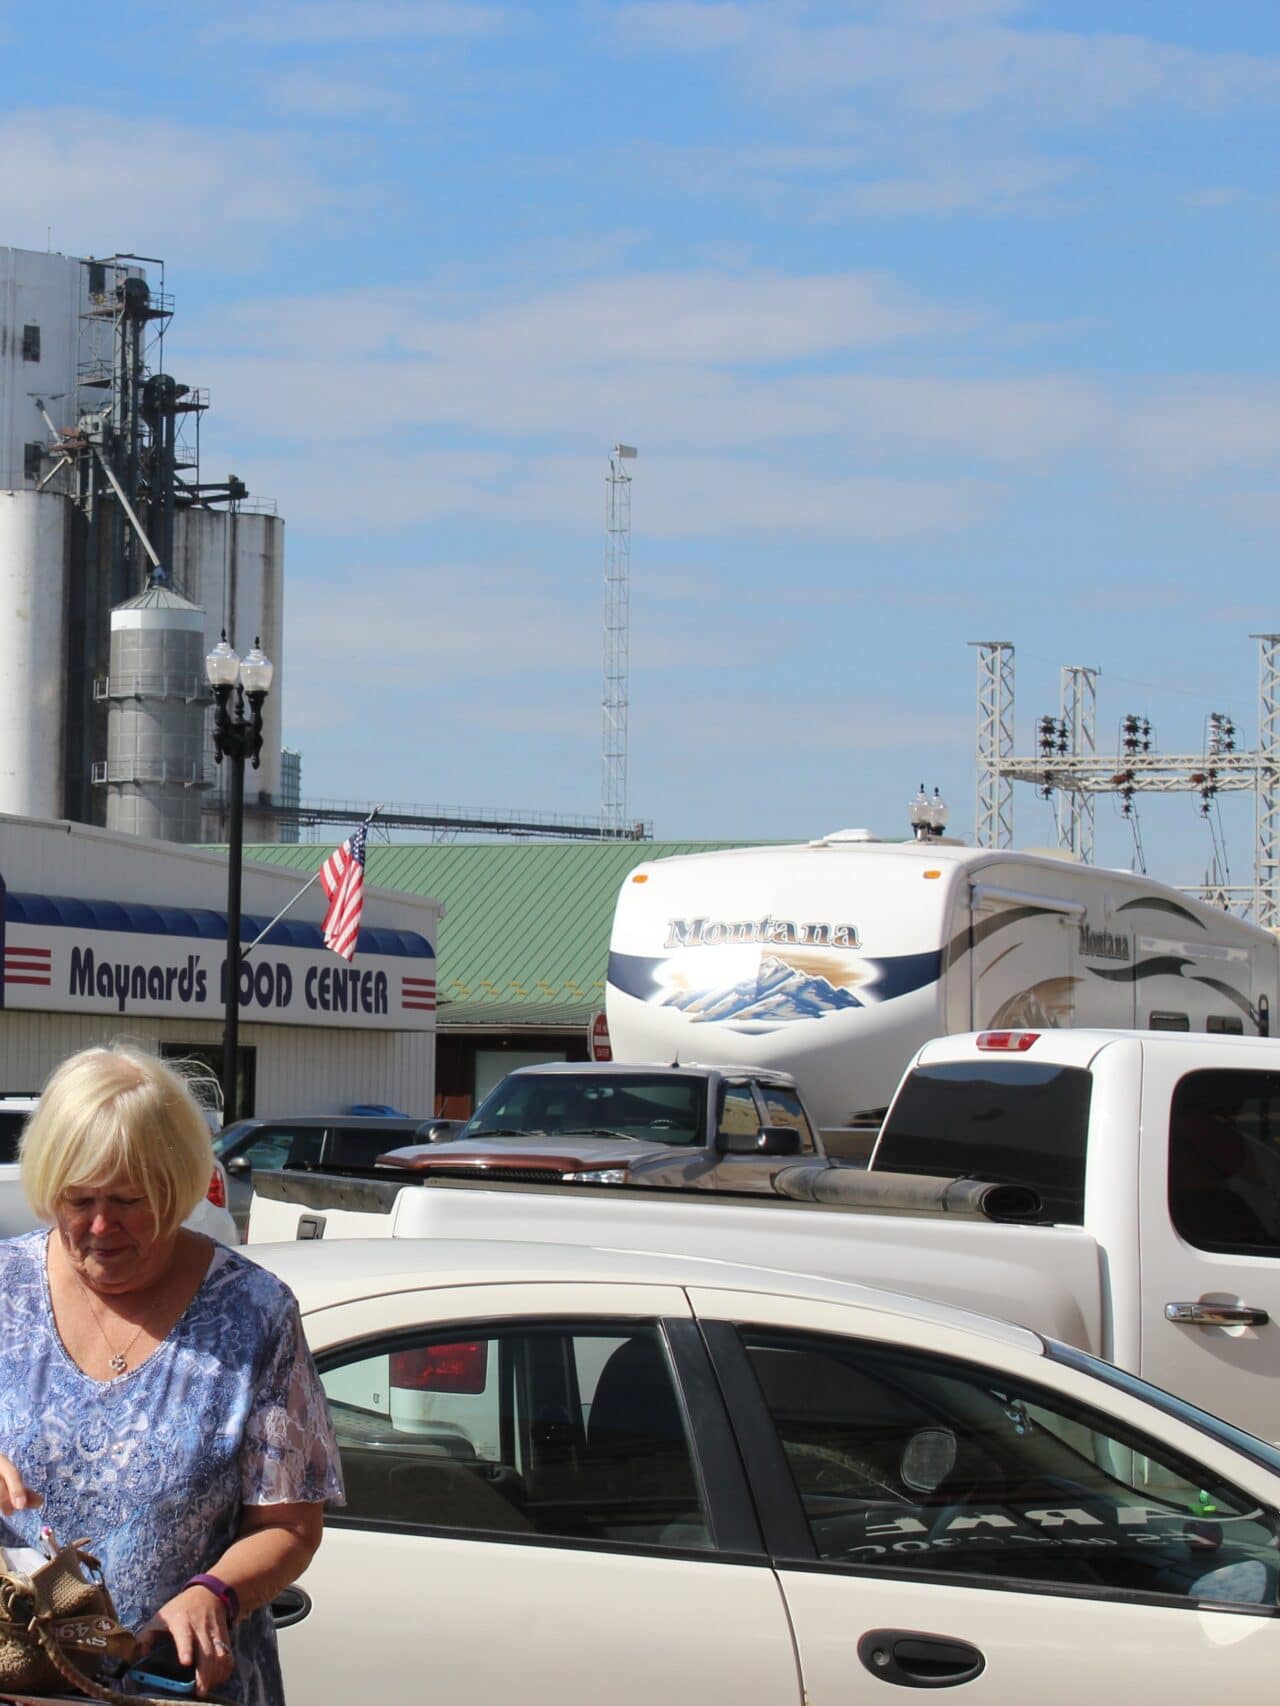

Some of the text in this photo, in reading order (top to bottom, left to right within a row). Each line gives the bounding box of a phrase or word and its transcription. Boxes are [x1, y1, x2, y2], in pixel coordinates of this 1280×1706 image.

[664, 914, 862, 949] Montana
[70, 946, 207, 1012] Maynard's
[305, 966, 388, 1015] CENTER
